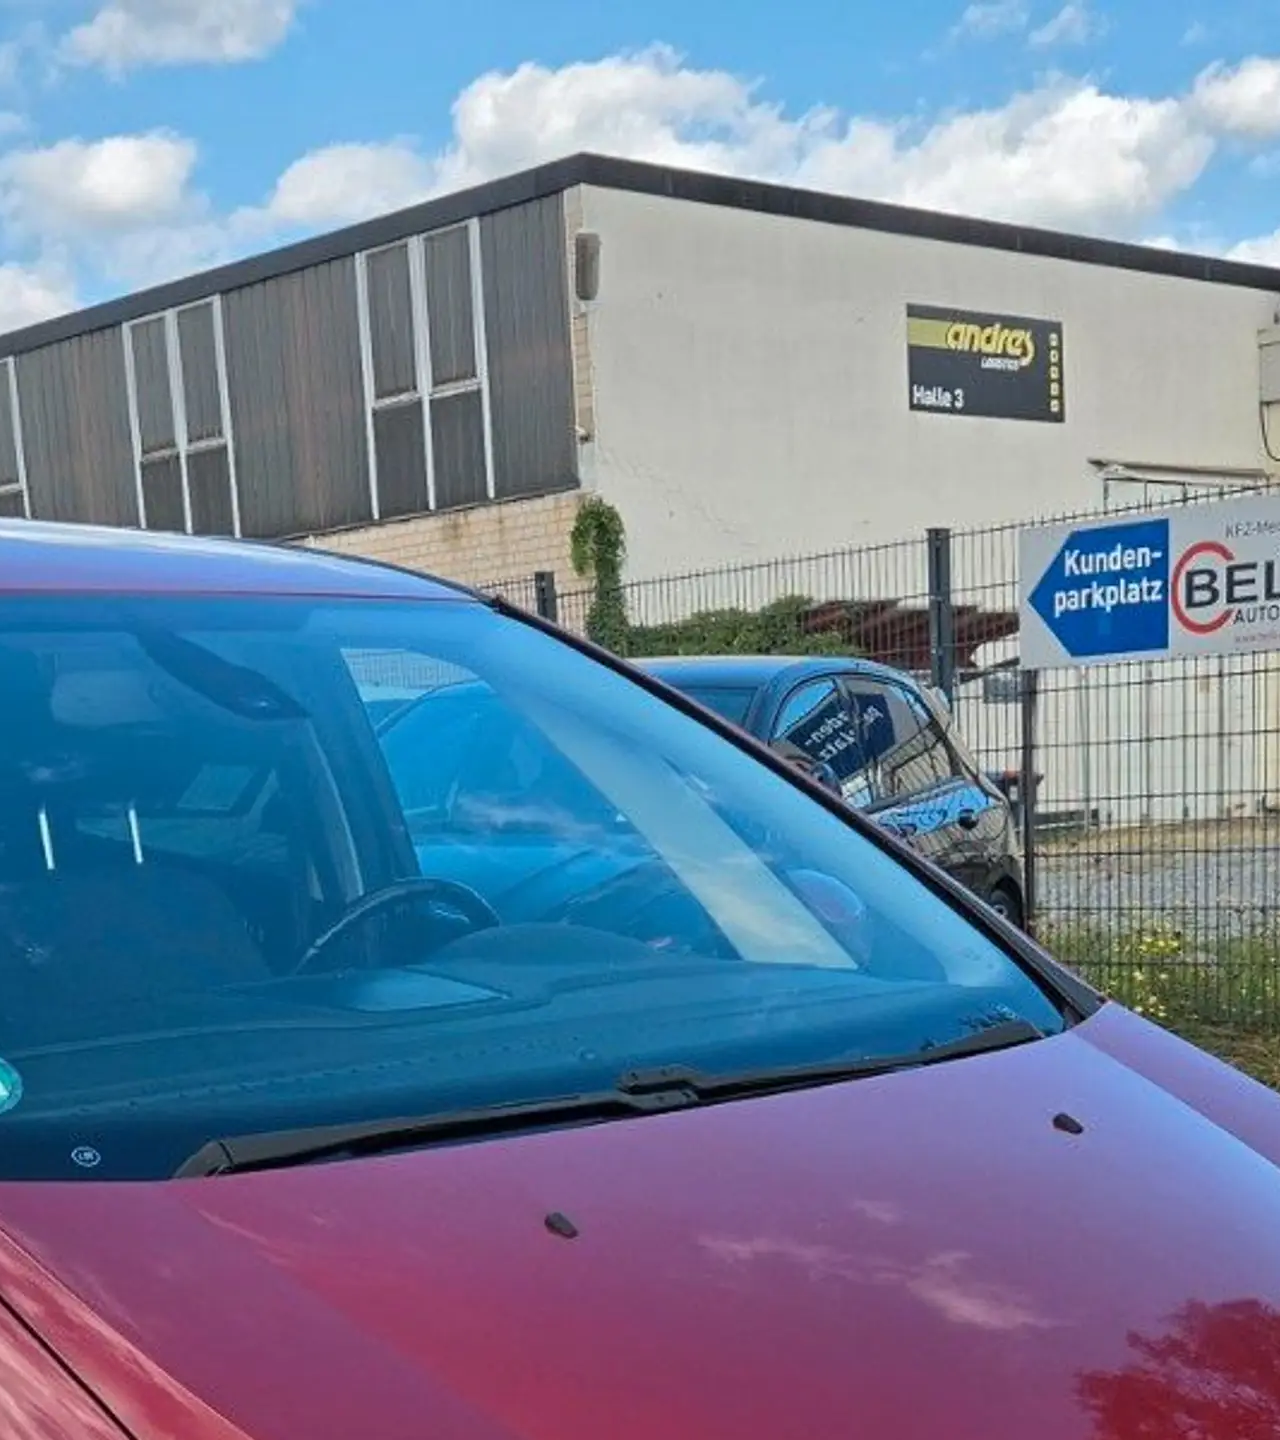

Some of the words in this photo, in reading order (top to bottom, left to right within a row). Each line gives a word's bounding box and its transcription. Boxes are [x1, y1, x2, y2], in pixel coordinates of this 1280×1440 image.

[945, 320, 1035, 367] andres
[911, 383, 953, 408] Halle
[954, 388, 965, 409] 3
[1063, 544, 1163, 577] Kunden-
[1054, 578, 1163, 618] parkplatz
